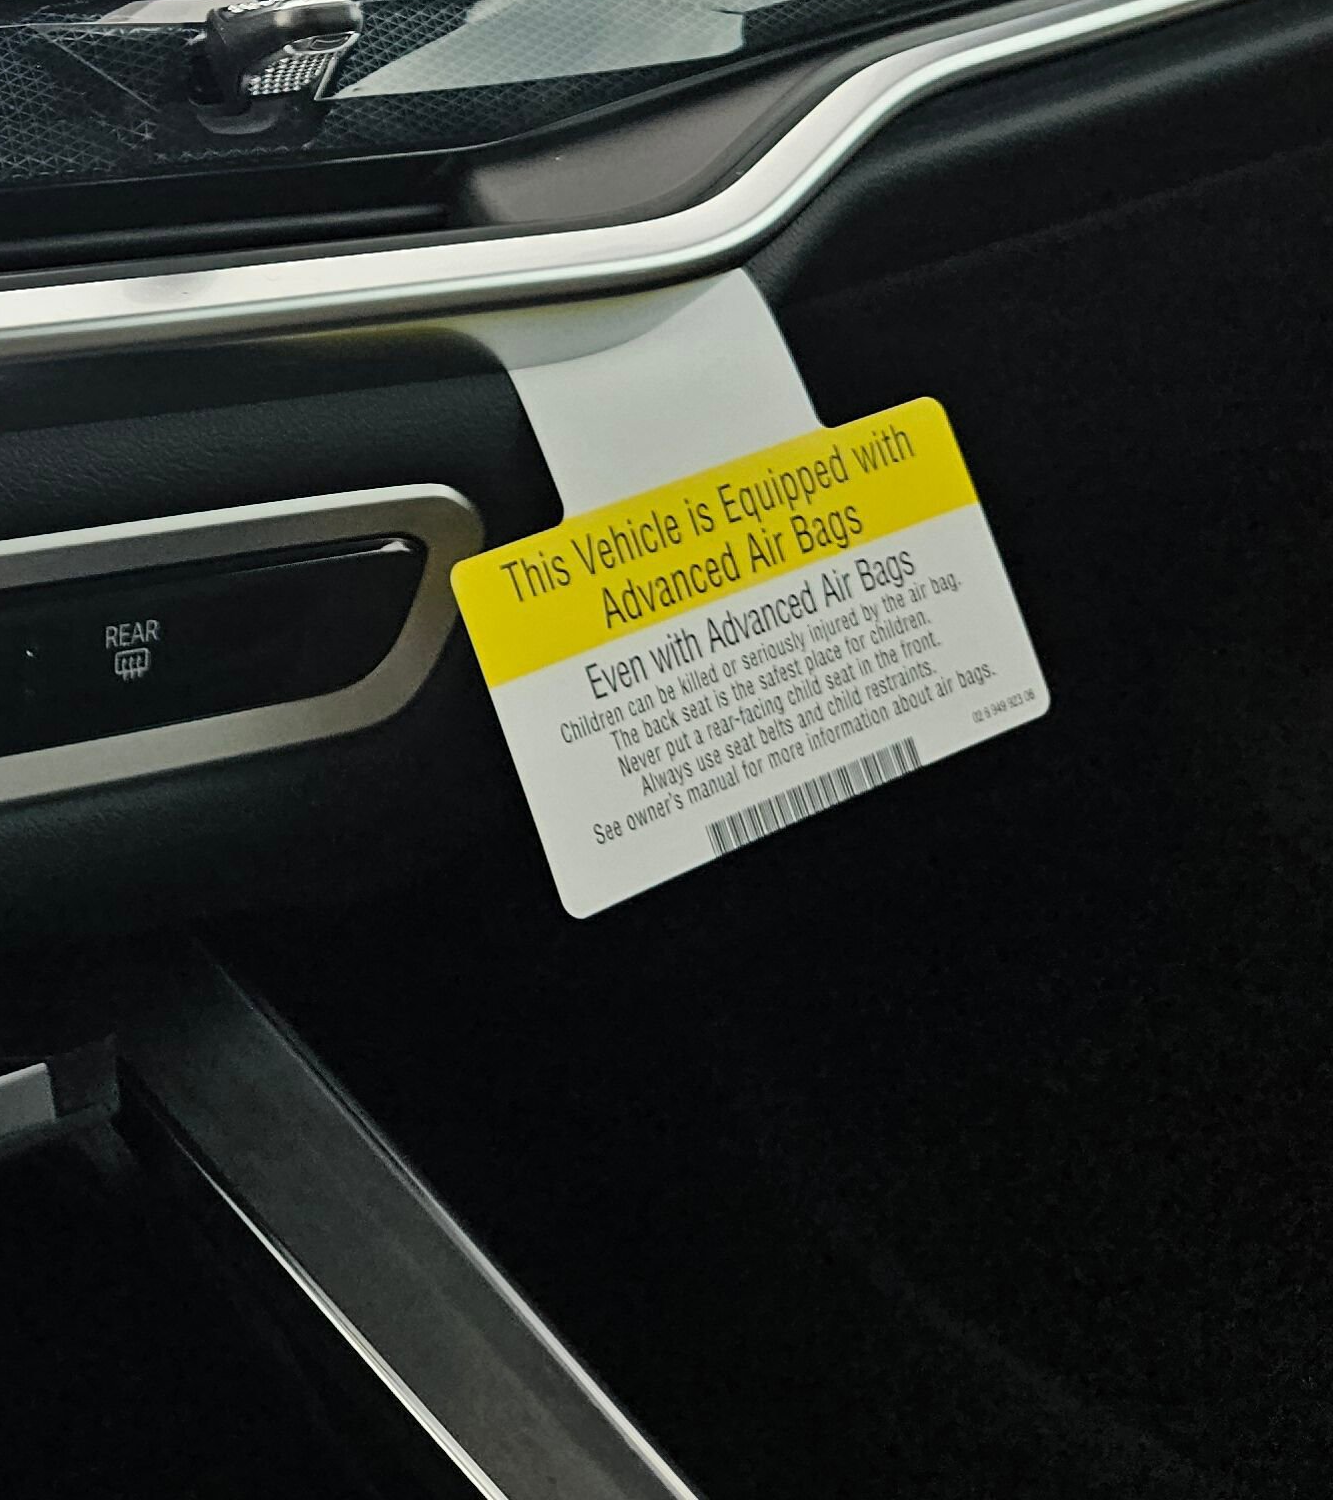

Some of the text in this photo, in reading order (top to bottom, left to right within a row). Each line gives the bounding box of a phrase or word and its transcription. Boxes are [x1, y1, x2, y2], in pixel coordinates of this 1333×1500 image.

[499, 424, 915, 603] This Vehicle is Equipped with
[601, 504, 864, 630] Advanced Air Bags
[105, 619, 161, 649] REAR
[560, 573, 962, 744] Children can be killed or seriously injured by the air bag.
[584, 550, 916, 700] Even with Advanced Air Bags
[609, 611, 931, 751] The back seat is the safest place for children.
[592, 820, 624, 845] See
[686, 764, 741, 805] manual
[741, 758, 763, 780] for
[767, 741, 805, 770] more
[805, 705, 890, 752] information
[892, 685, 934, 716] about
[935, 676, 954, 698] air
[955, 663, 996, 689] bags.
[617, 631, 941, 778] Never put a rear-facing child seat in the front.
[641, 660, 937, 797] Always use seat belts and child restraints.
